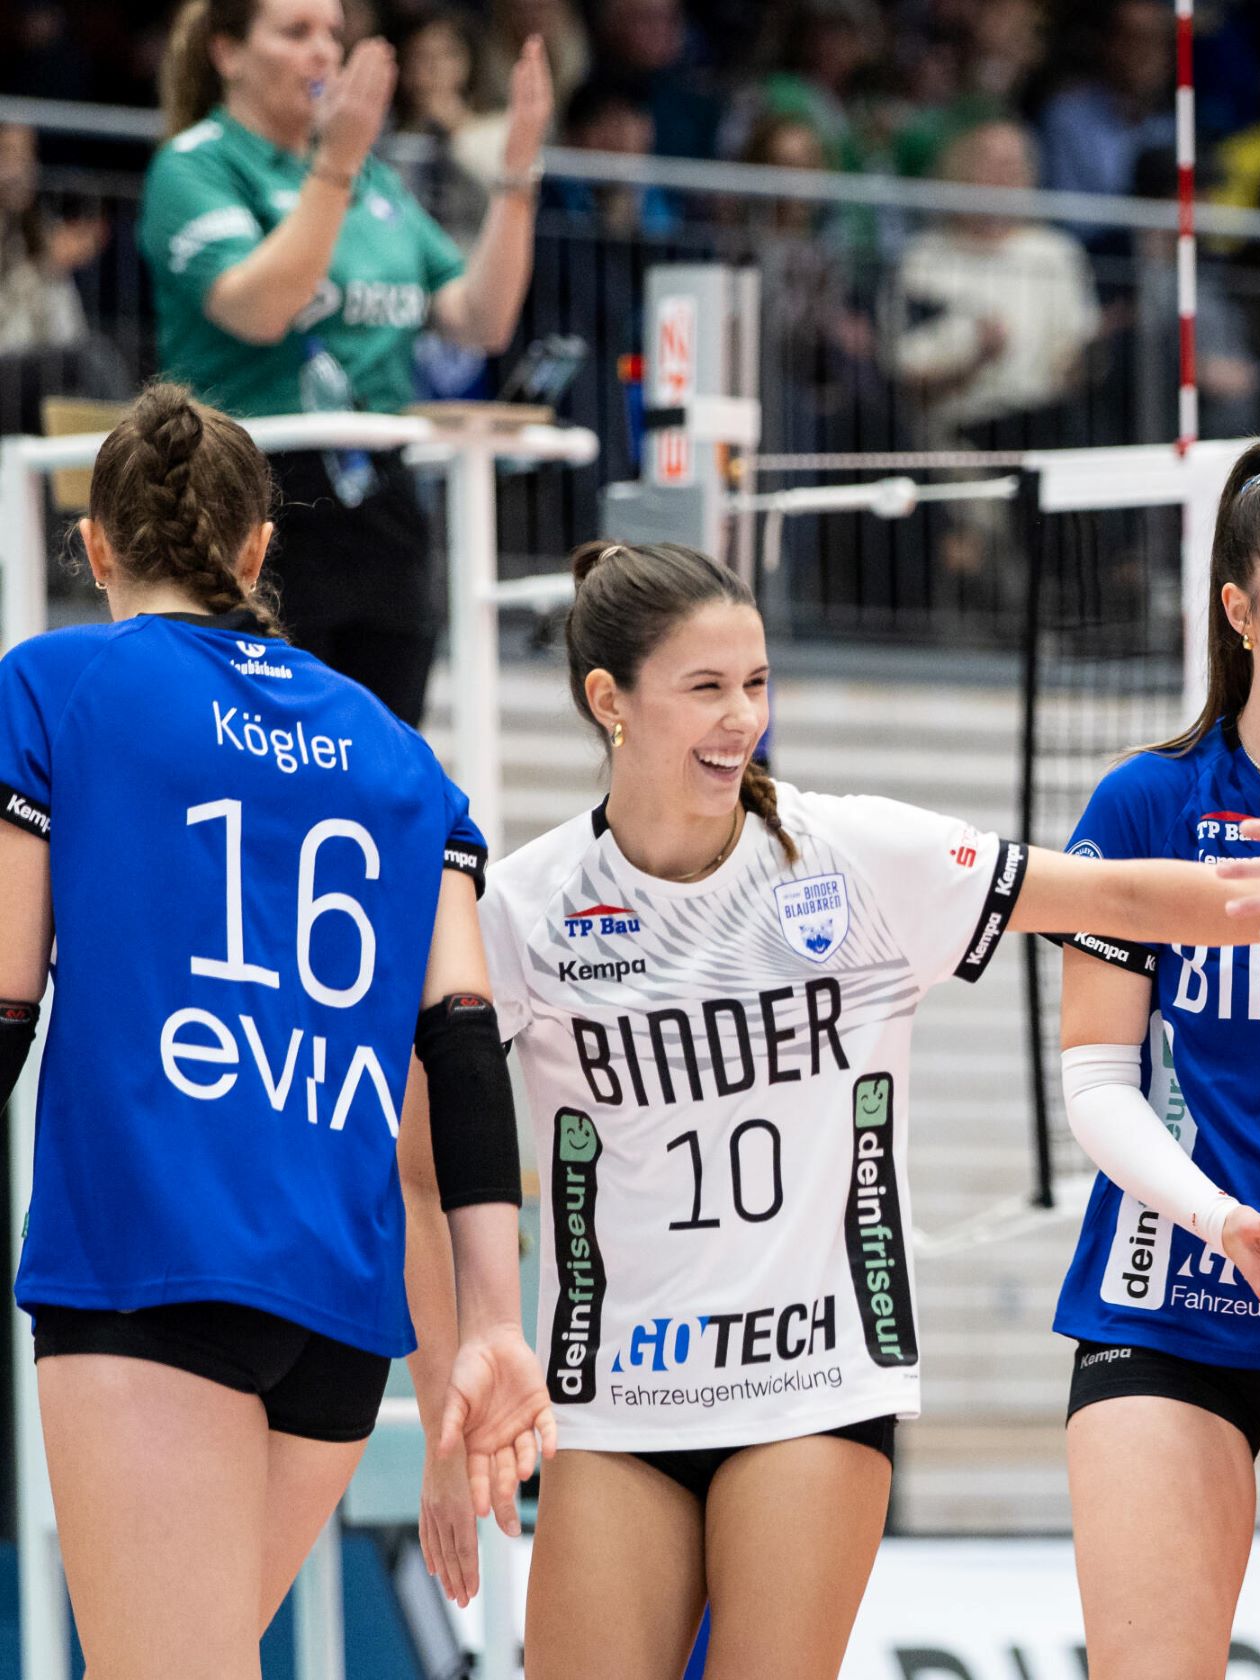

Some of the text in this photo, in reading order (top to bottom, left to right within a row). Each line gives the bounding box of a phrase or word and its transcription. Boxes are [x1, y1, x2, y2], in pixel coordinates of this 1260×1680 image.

[213, 700, 353, 774] Kögler
[1197, 820, 1220, 840] TP
[444, 849, 478, 868] mpa
[186, 798, 381, 1009] 16
[803, 880, 840, 900] BINDER
[565, 916, 640, 937] TP Bau
[966, 912, 1002, 965] Kempa
[1074, 931, 1130, 962] Kempa
[558, 956, 647, 983] Kempa
[571, 976, 851, 1107] BINDER
[667, 1118, 784, 1231] 10
[857, 1130, 905, 1361] deinfriseur
[557, 1166, 588, 1396] deinfriseur
[1080, 1347, 1132, 1369] Kempa
[611, 1365, 844, 1408] Fahrzeugentwicklung
